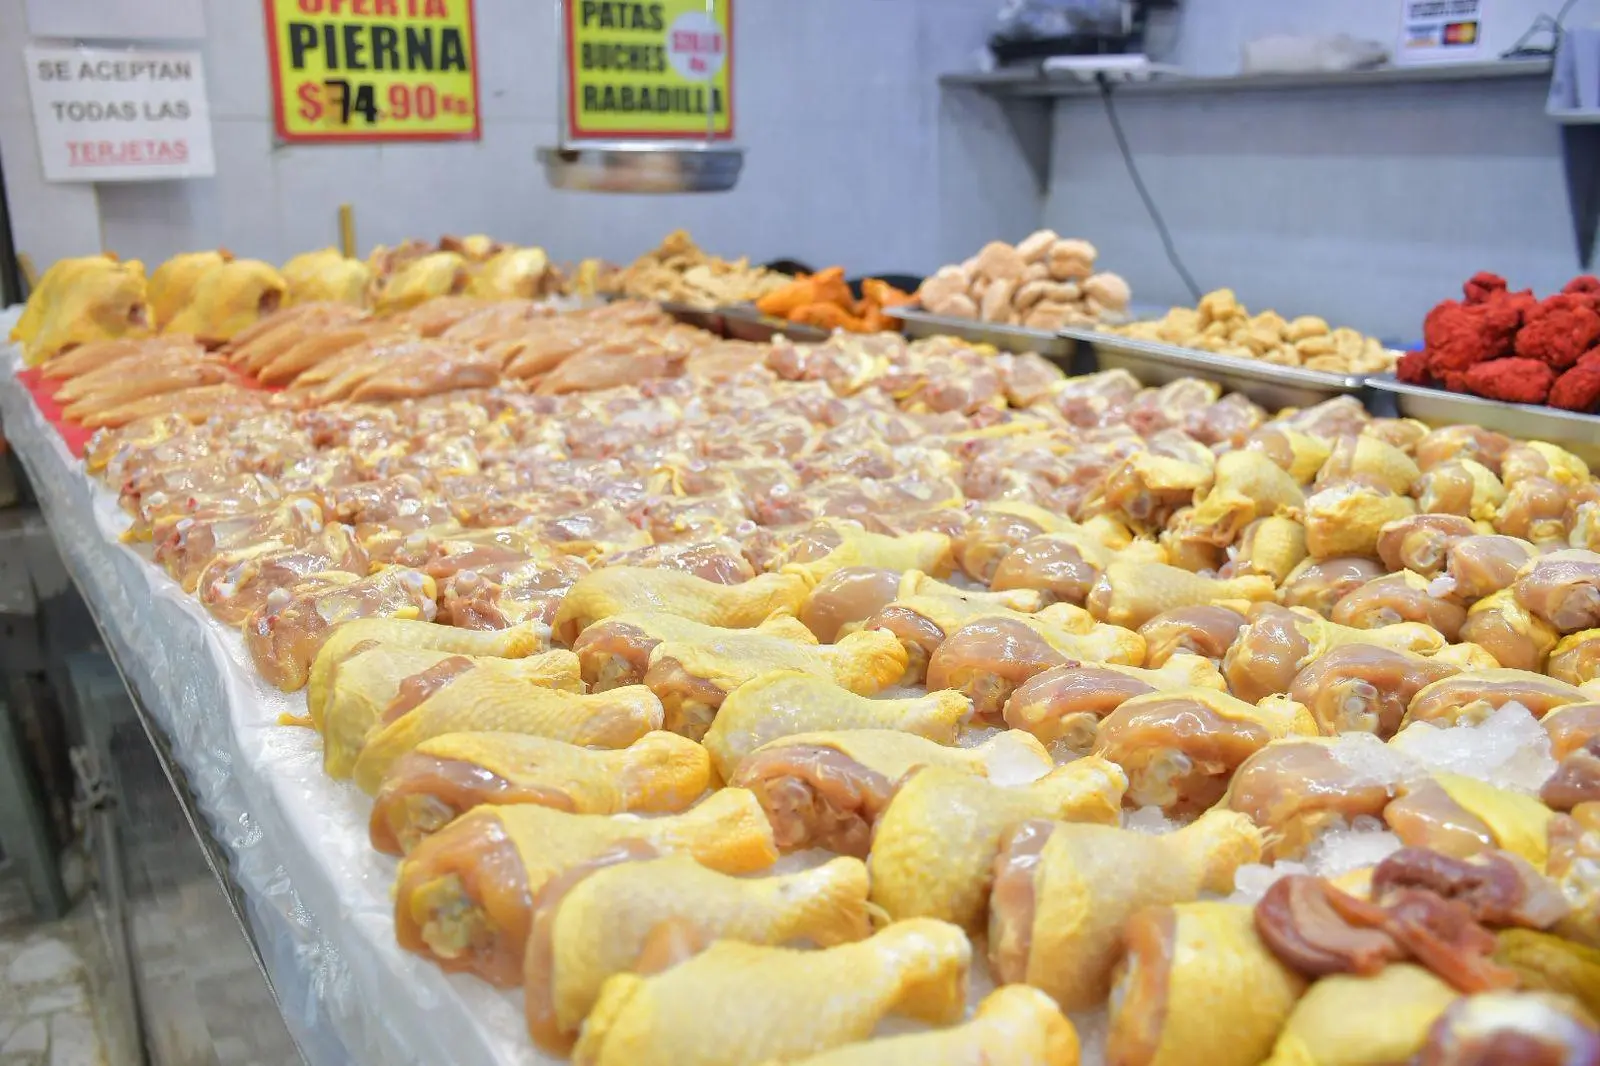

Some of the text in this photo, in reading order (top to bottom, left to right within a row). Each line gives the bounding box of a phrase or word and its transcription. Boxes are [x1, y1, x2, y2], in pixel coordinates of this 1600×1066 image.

[581, 0, 664, 30] PATAS
[289, 22, 468, 71] PIERNA
[581, 42, 667, 72] BUCHES
[37, 59, 192, 81] SE ACEPTAN
[51, 100, 191, 122] TODAS LAS
[583, 84, 723, 113] RABADILLA
[66, 138, 190, 165] TERJETAS
